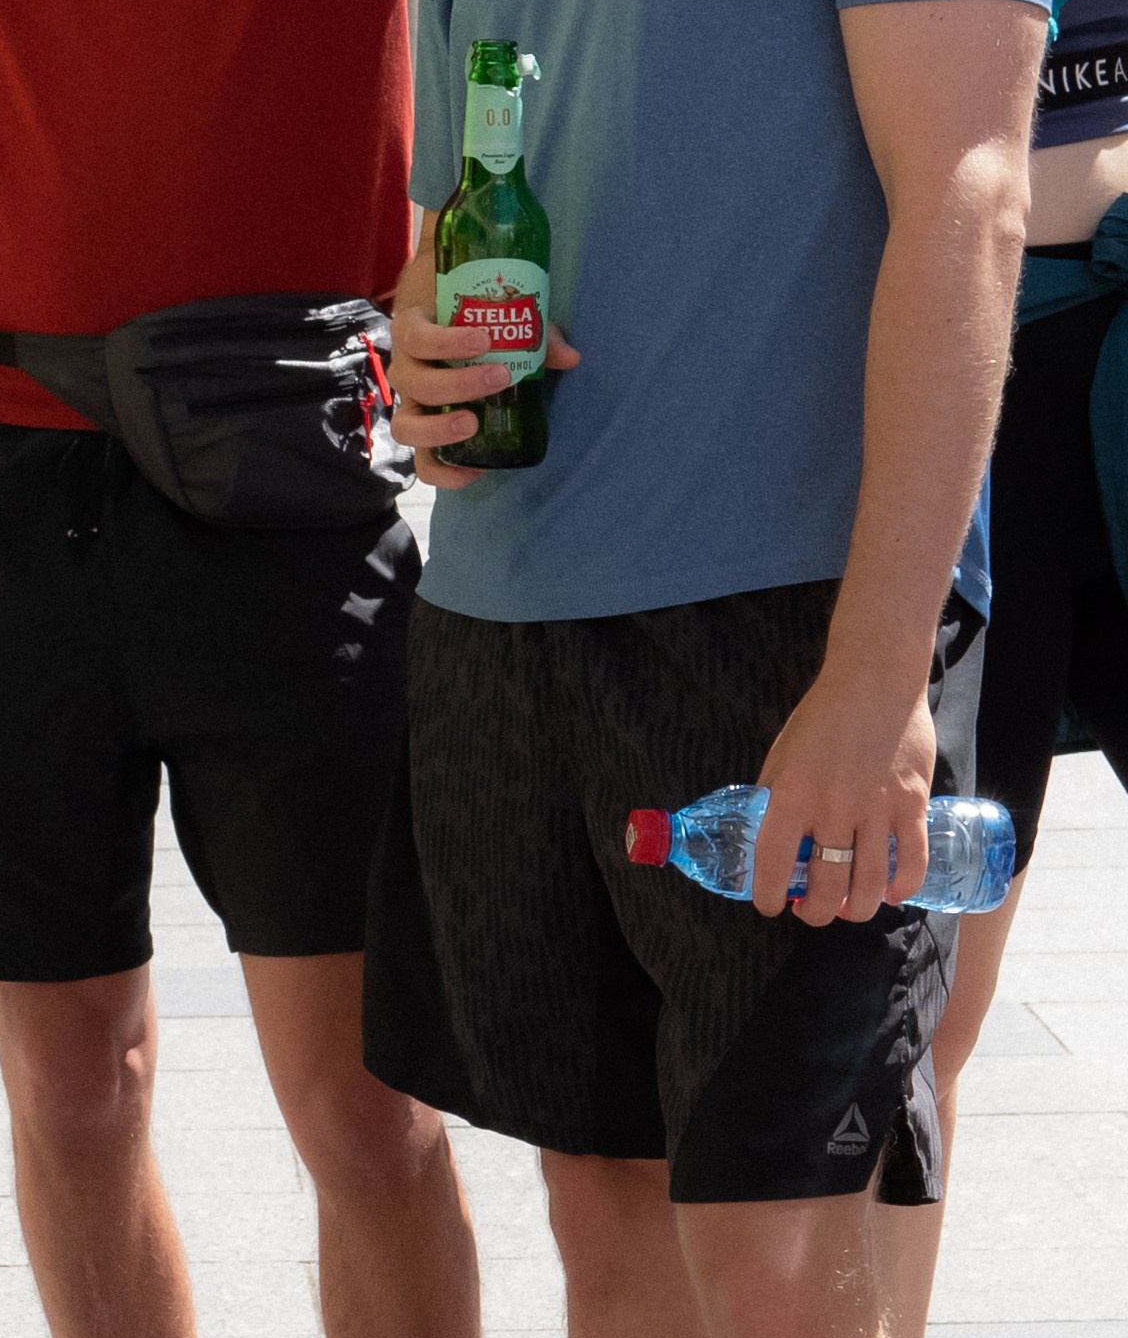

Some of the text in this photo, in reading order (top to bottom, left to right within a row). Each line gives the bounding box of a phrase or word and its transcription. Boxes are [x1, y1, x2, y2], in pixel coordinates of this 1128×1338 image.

[486, 108, 511, 126] 0.0
[463, 306, 533, 324] STELLA
[476, 323, 533, 341] TOIS
